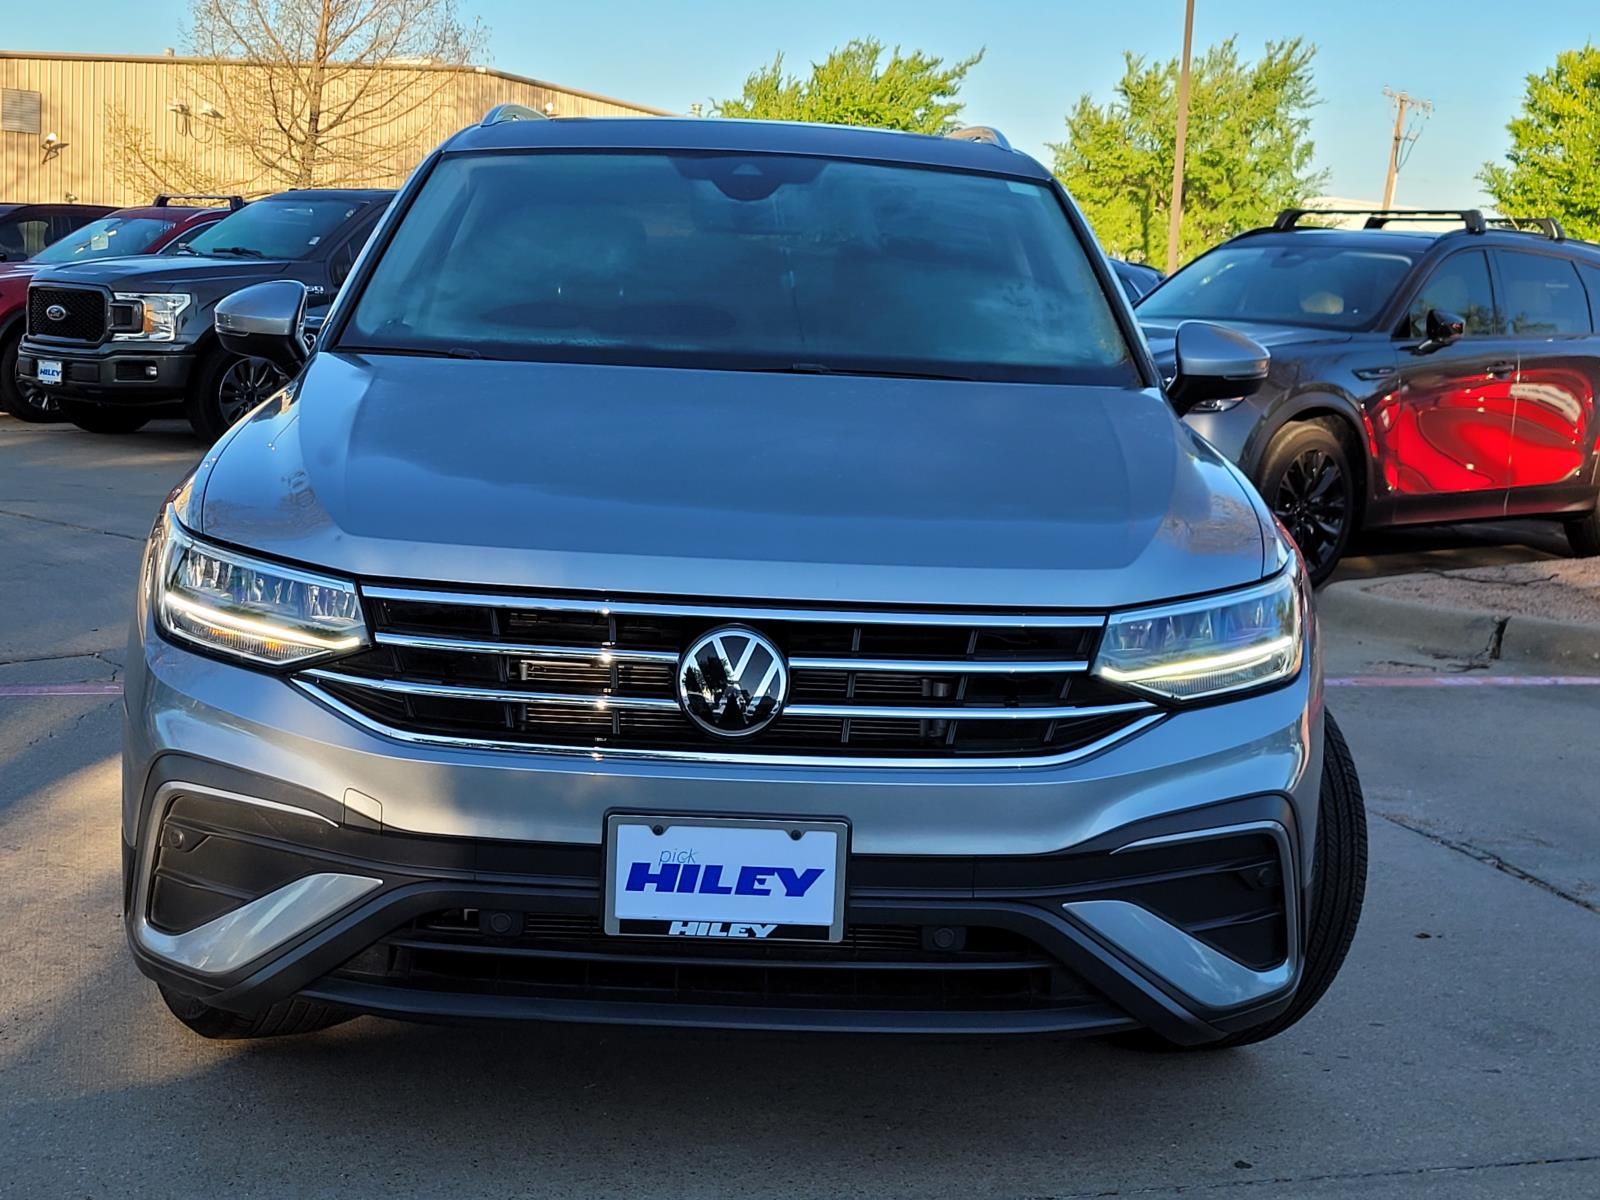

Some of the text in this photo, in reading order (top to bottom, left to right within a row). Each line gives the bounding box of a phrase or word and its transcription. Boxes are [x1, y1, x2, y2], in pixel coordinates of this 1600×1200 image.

[658, 847, 696, 866] pick
[625, 862, 825, 897] HILEY
[668, 921, 778, 938] HILEY
